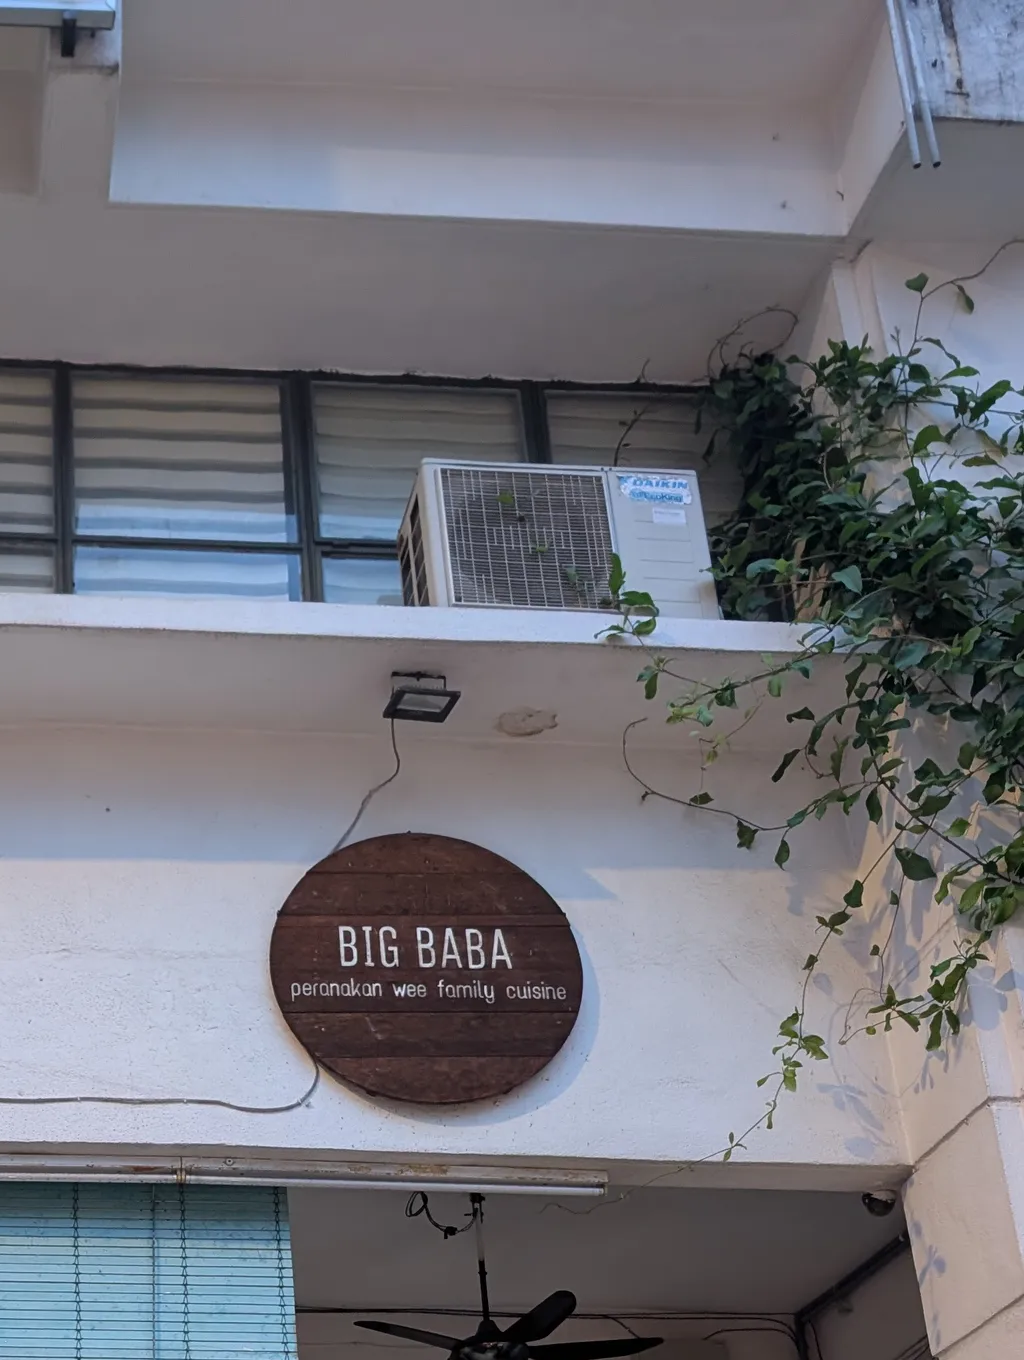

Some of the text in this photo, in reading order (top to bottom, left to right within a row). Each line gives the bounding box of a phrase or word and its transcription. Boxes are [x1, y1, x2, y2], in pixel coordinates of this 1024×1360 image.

[632, 478, 688, 489] DAIKIN
[338, 925, 513, 970] BIG BABA
[290, 978, 567, 1004] peranakan wee family cuisine
